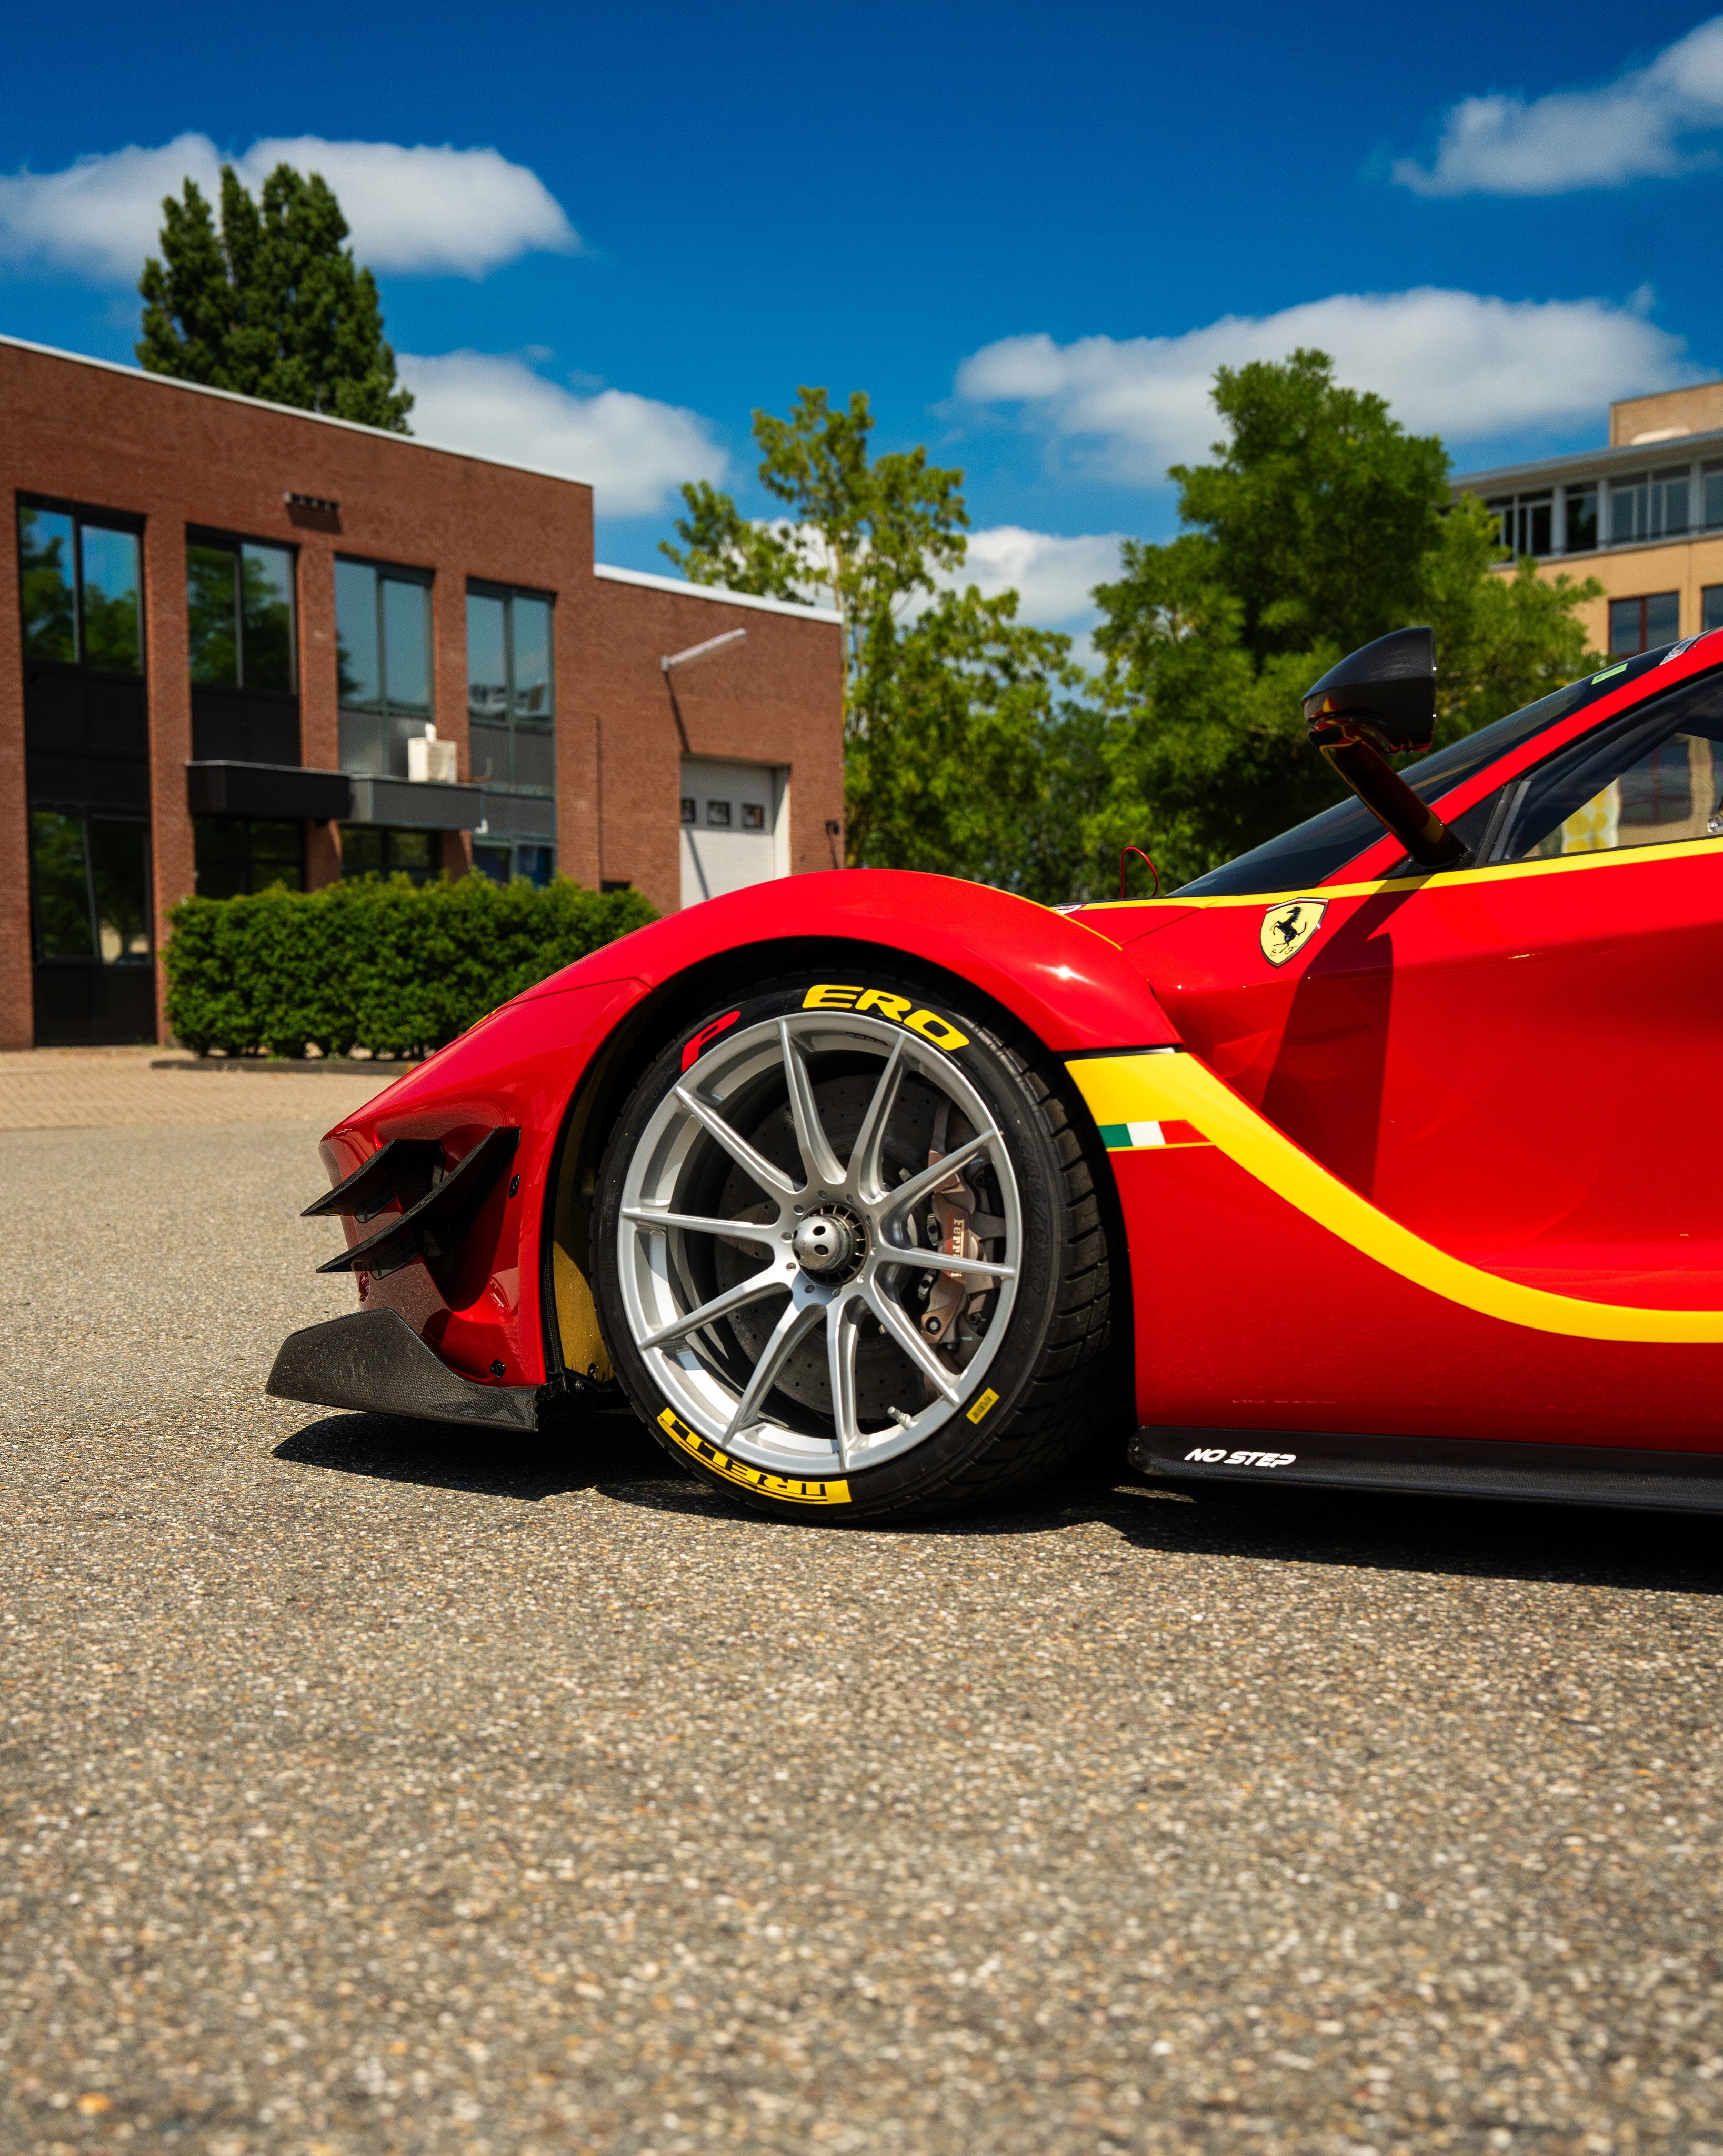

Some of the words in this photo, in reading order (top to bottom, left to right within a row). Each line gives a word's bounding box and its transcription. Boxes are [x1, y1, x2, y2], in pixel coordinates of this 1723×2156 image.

[802, 984, 970, 1051] ERO
[950, 1219, 965, 1277] Ferri
[1184, 1448, 1227, 1462] NO
[1223, 1451, 1296, 1468] STEP
